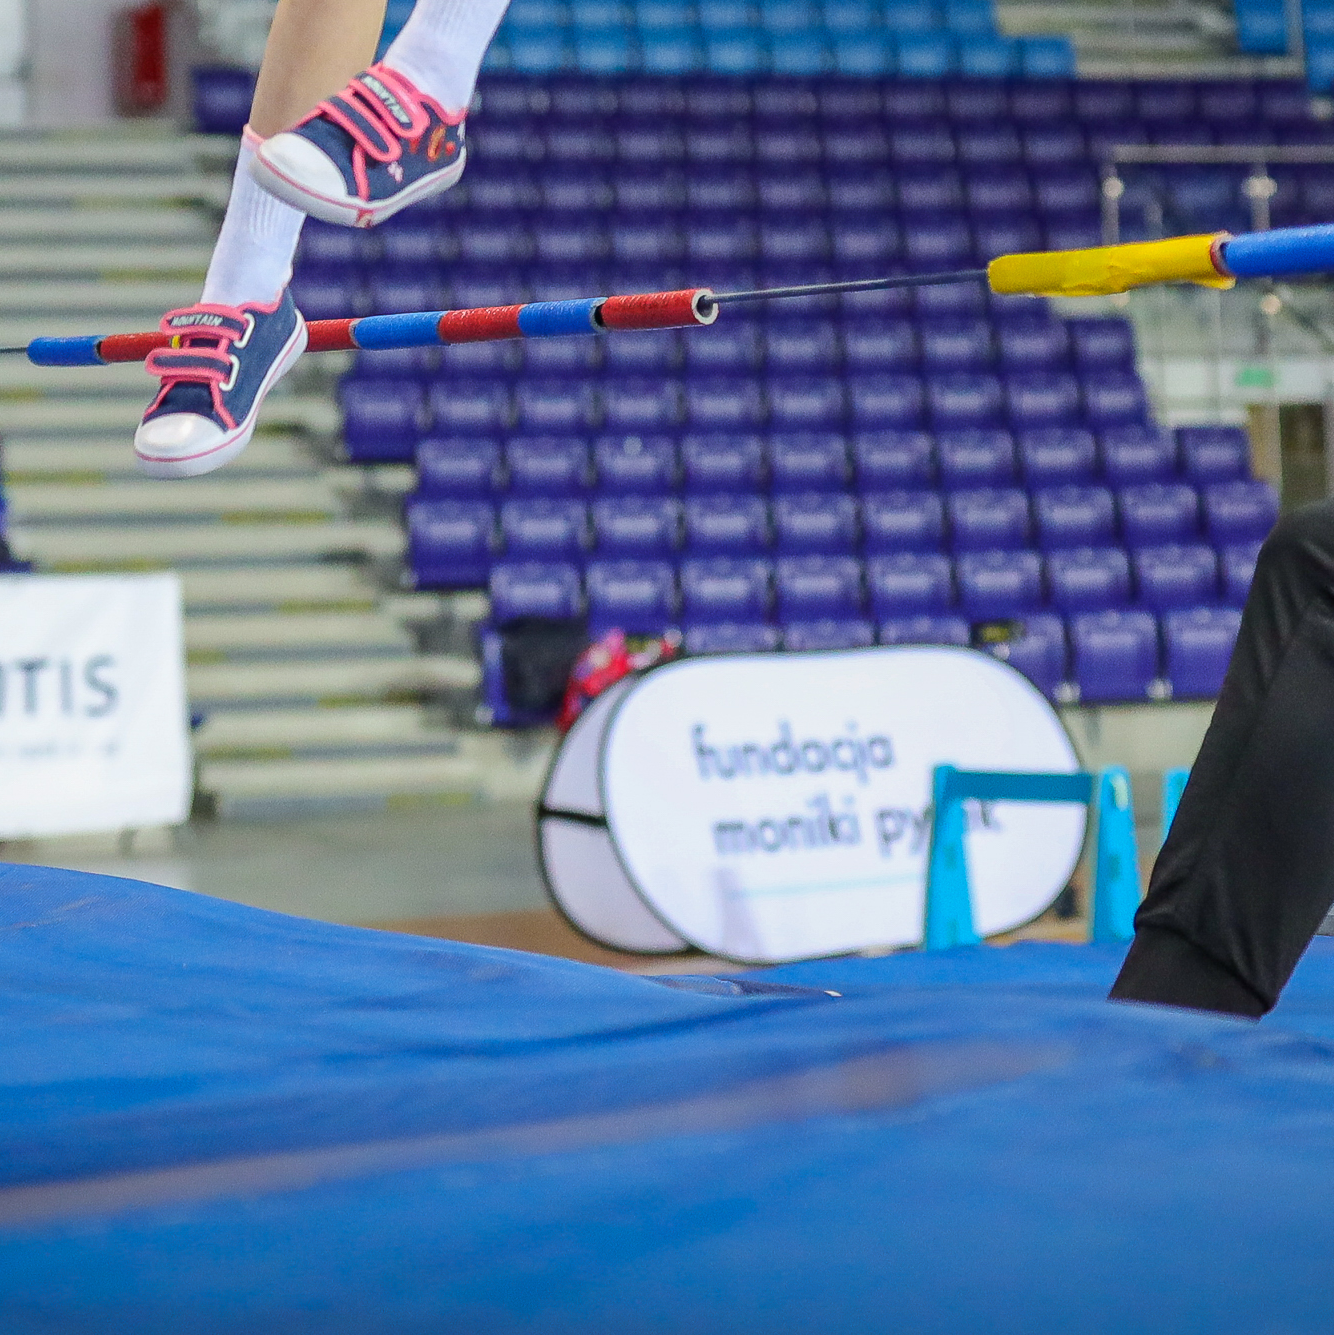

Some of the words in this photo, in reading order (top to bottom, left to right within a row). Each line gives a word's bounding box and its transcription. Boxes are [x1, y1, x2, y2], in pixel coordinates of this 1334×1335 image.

[170, 313, 224, 327] MOUNTAIN
[690, 718, 895, 787] fundacja
[711, 790, 863, 855] moniki
